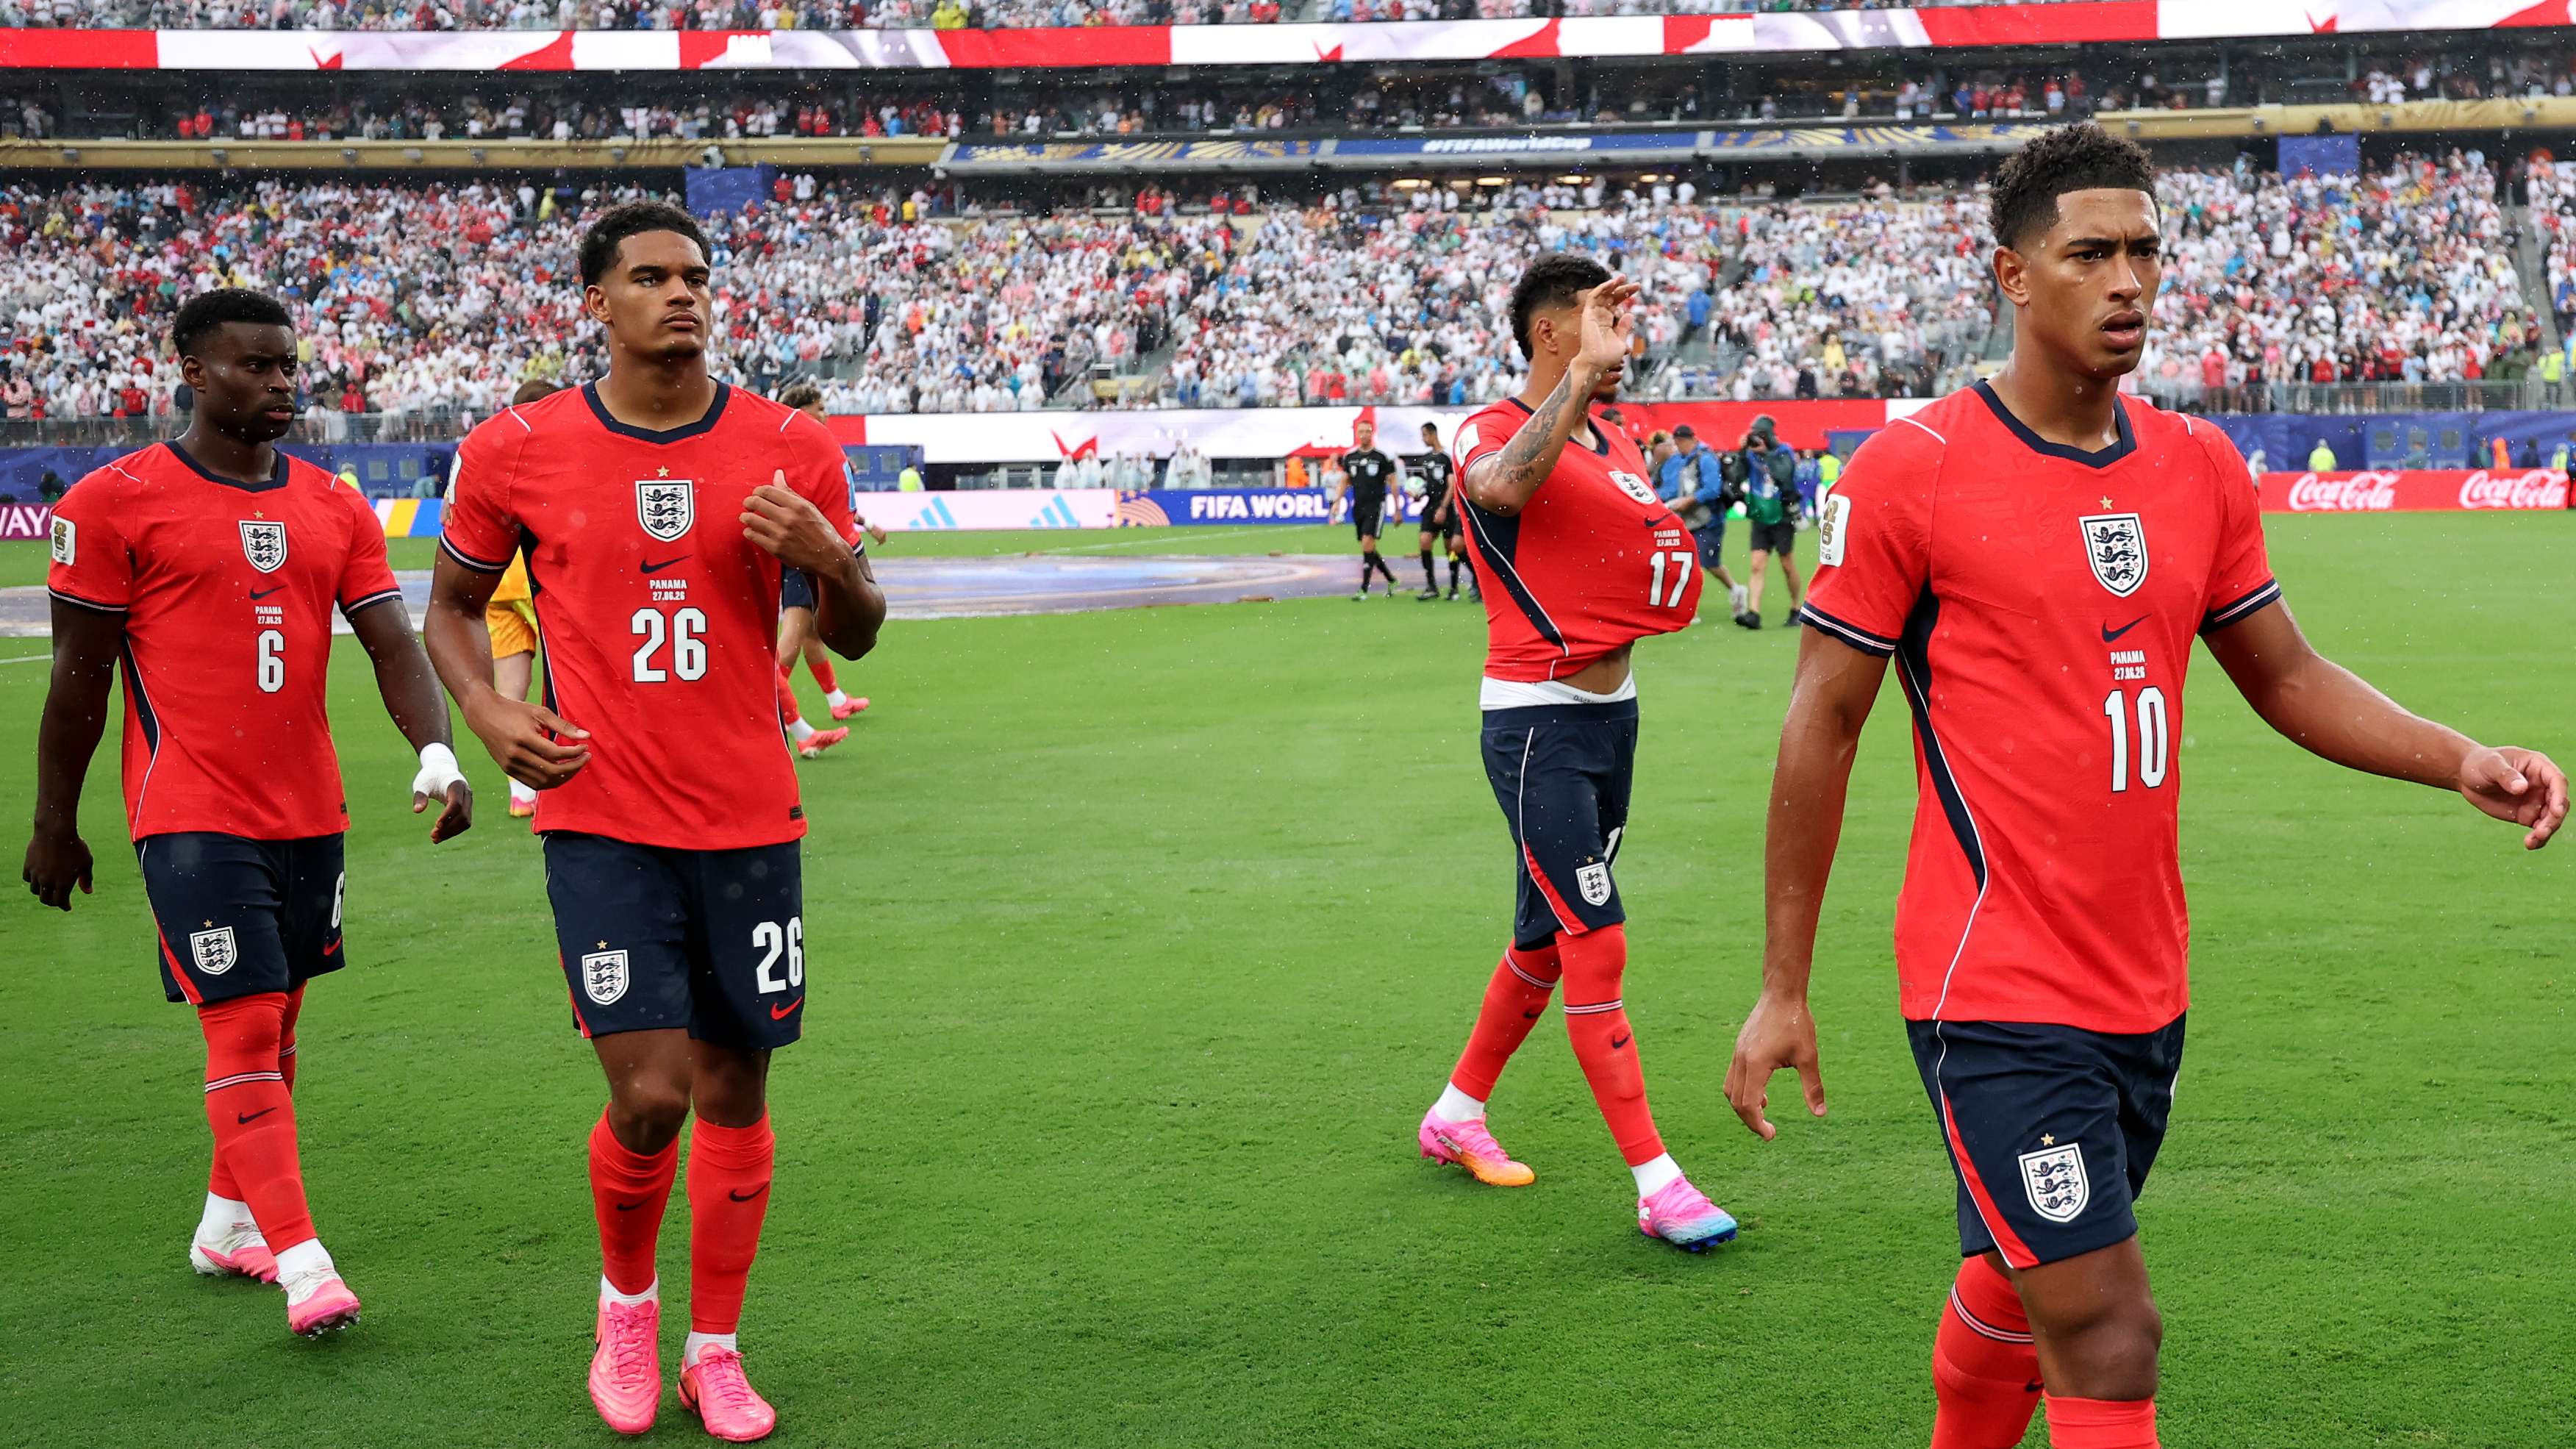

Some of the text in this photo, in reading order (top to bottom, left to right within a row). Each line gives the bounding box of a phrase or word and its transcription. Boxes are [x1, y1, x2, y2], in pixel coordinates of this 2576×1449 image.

[1421, 137, 1592, 153] #FIFAWorldCup
[1190, 495, 1249, 519] FIFA
[1653, 529, 1681, 538] PANAMA
[649, 579, 687, 590] PANAMA
[1649, 551, 1693, 607] 17
[652, 591, 685, 601] 27.06.26
[255, 606, 283, 615] PANAMA
[632, 607, 707, 682] 26
[258, 629, 285, 693] 6
[2110, 651, 2145, 665] PANAMA
[2114, 666, 2145, 680] 27.06.26
[2104, 686, 2168, 793] 10
[332, 871, 344, 929] 6
[753, 917, 803, 994] 26
